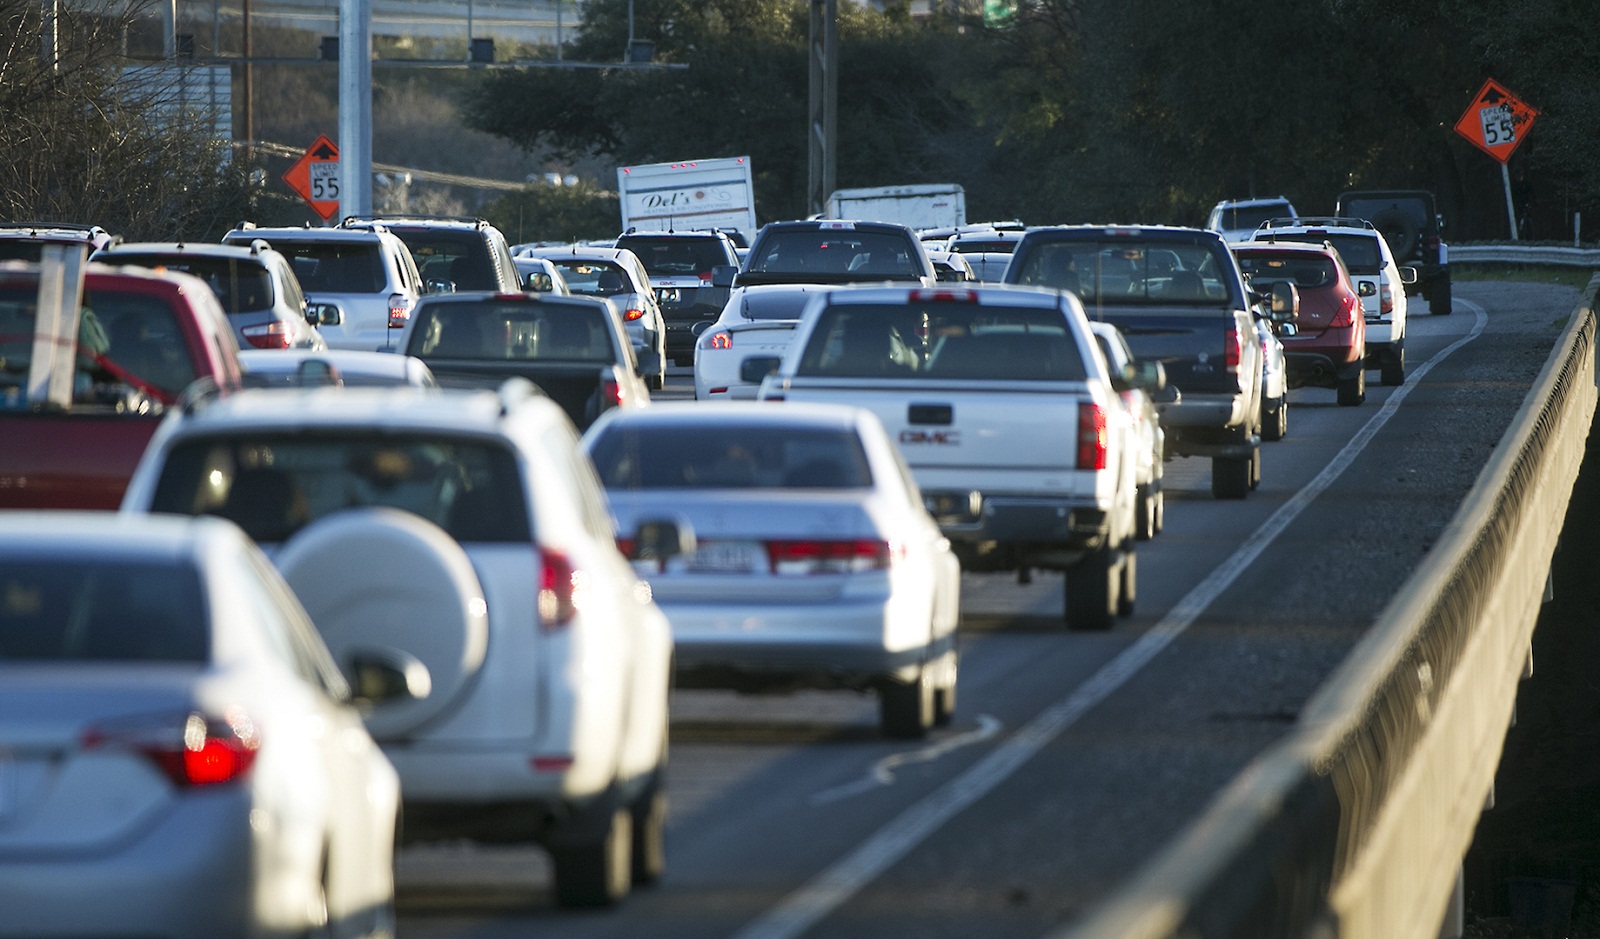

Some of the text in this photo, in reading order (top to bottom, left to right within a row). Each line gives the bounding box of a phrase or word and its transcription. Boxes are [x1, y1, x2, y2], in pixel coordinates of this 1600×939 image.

[1486, 113, 1507, 123] LIMIT
[1485, 120, 1514, 144] 55
[313, 177, 339, 199] 55
[641, 192, 690, 208] Del's
[897, 430, 961, 446] GMC
